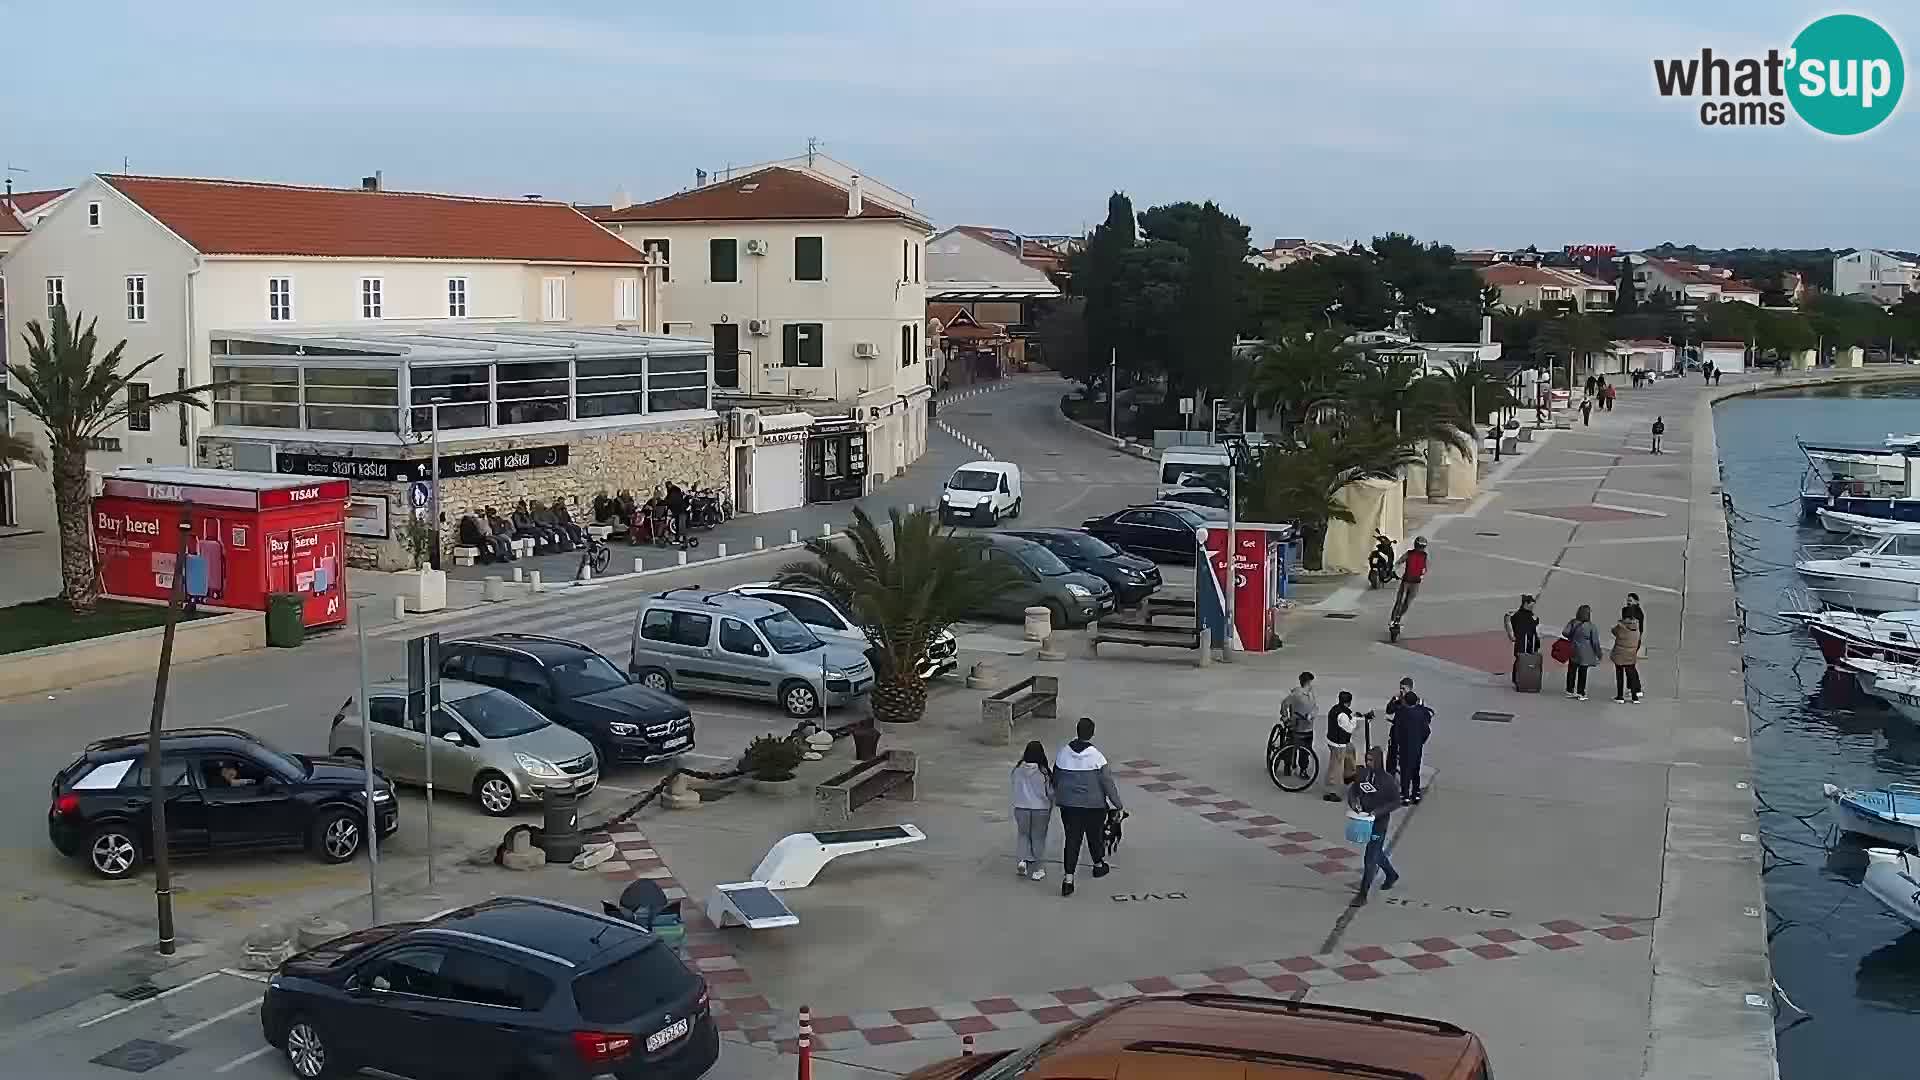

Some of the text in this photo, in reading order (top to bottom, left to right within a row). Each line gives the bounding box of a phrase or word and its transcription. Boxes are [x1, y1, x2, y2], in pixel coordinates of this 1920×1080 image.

[763, 432, 802, 445] MARKET
[146, 485, 185, 501] TISAK
[289, 487, 320, 501] TISAK
[98, 512, 160, 536] Buy here!
[271, 539, 289, 552] Buy
